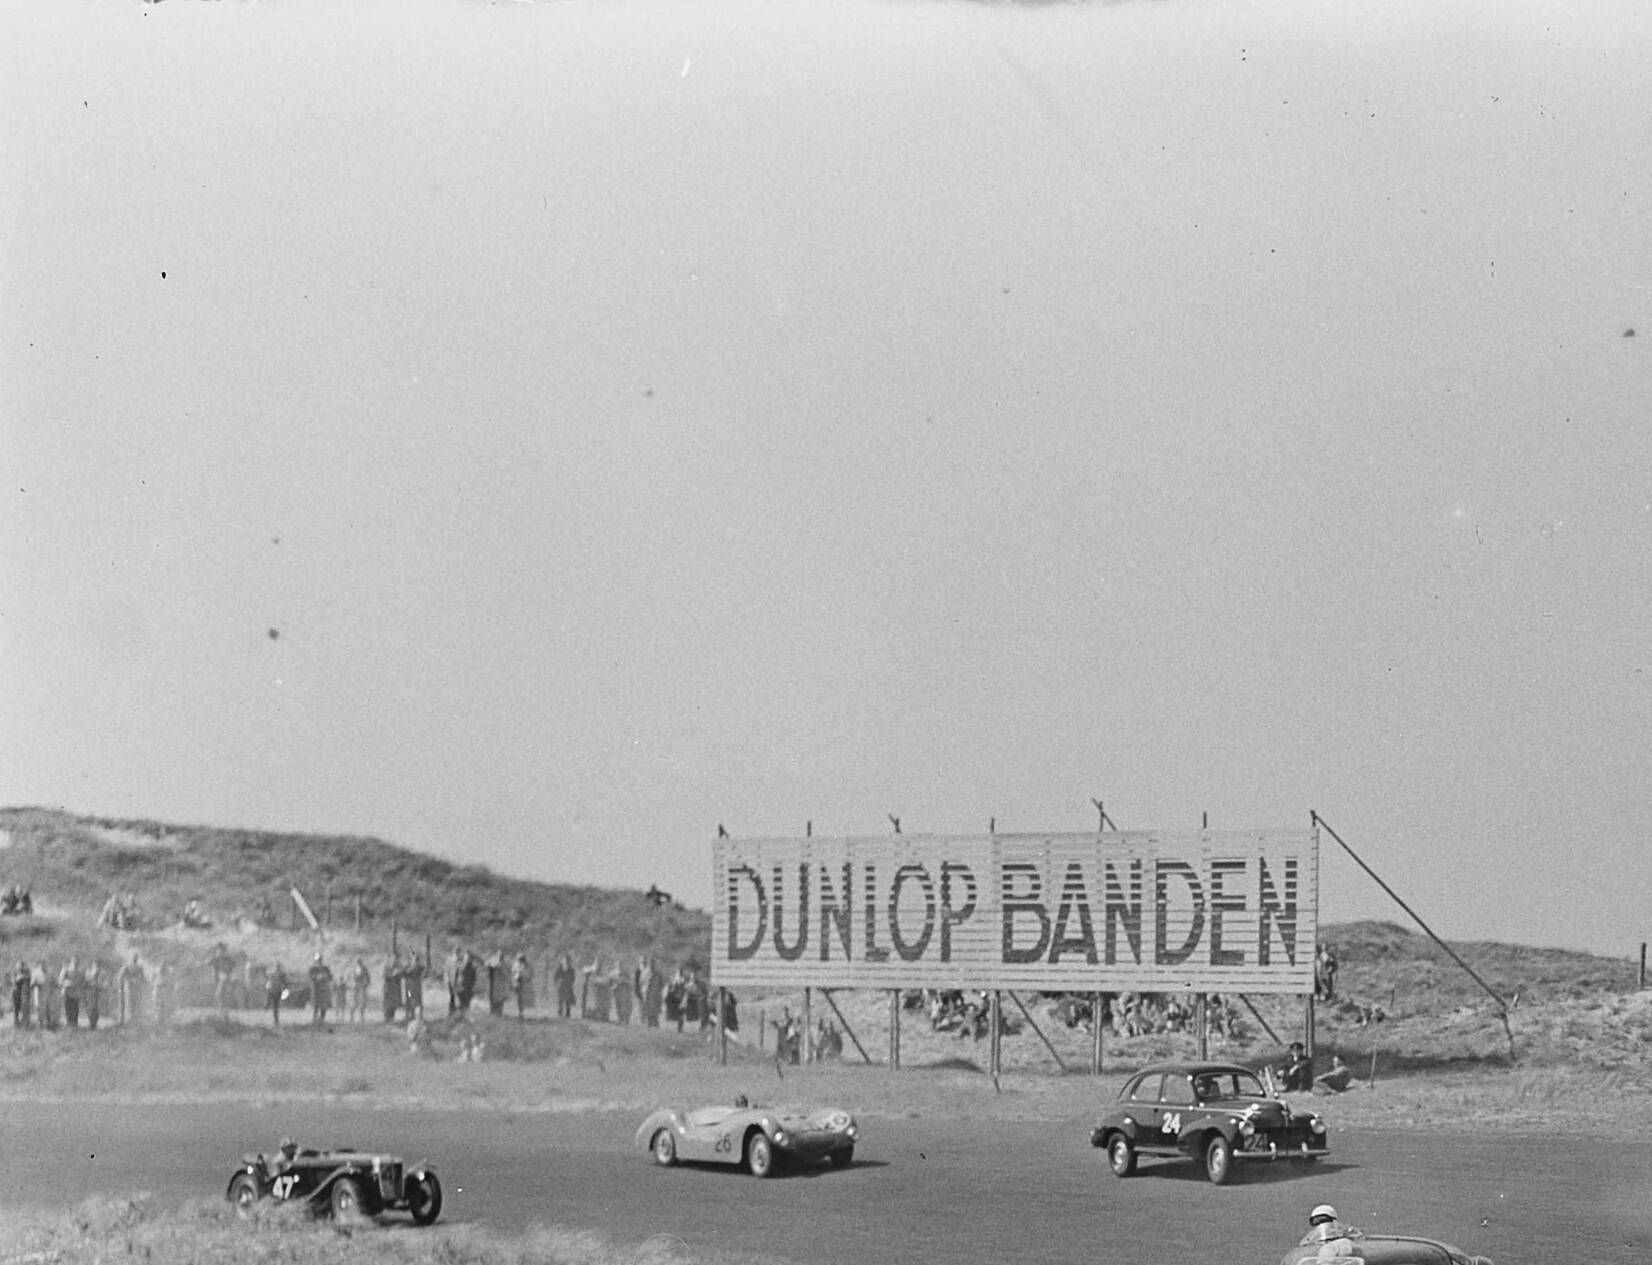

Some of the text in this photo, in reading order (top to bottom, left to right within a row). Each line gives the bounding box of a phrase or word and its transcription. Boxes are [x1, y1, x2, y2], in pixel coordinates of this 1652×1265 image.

[727, 858, 1298, 967] DUNLOP BANDEN
[1162, 1112, 1181, 1134] 24
[272, 1176, 294, 1200] 47
